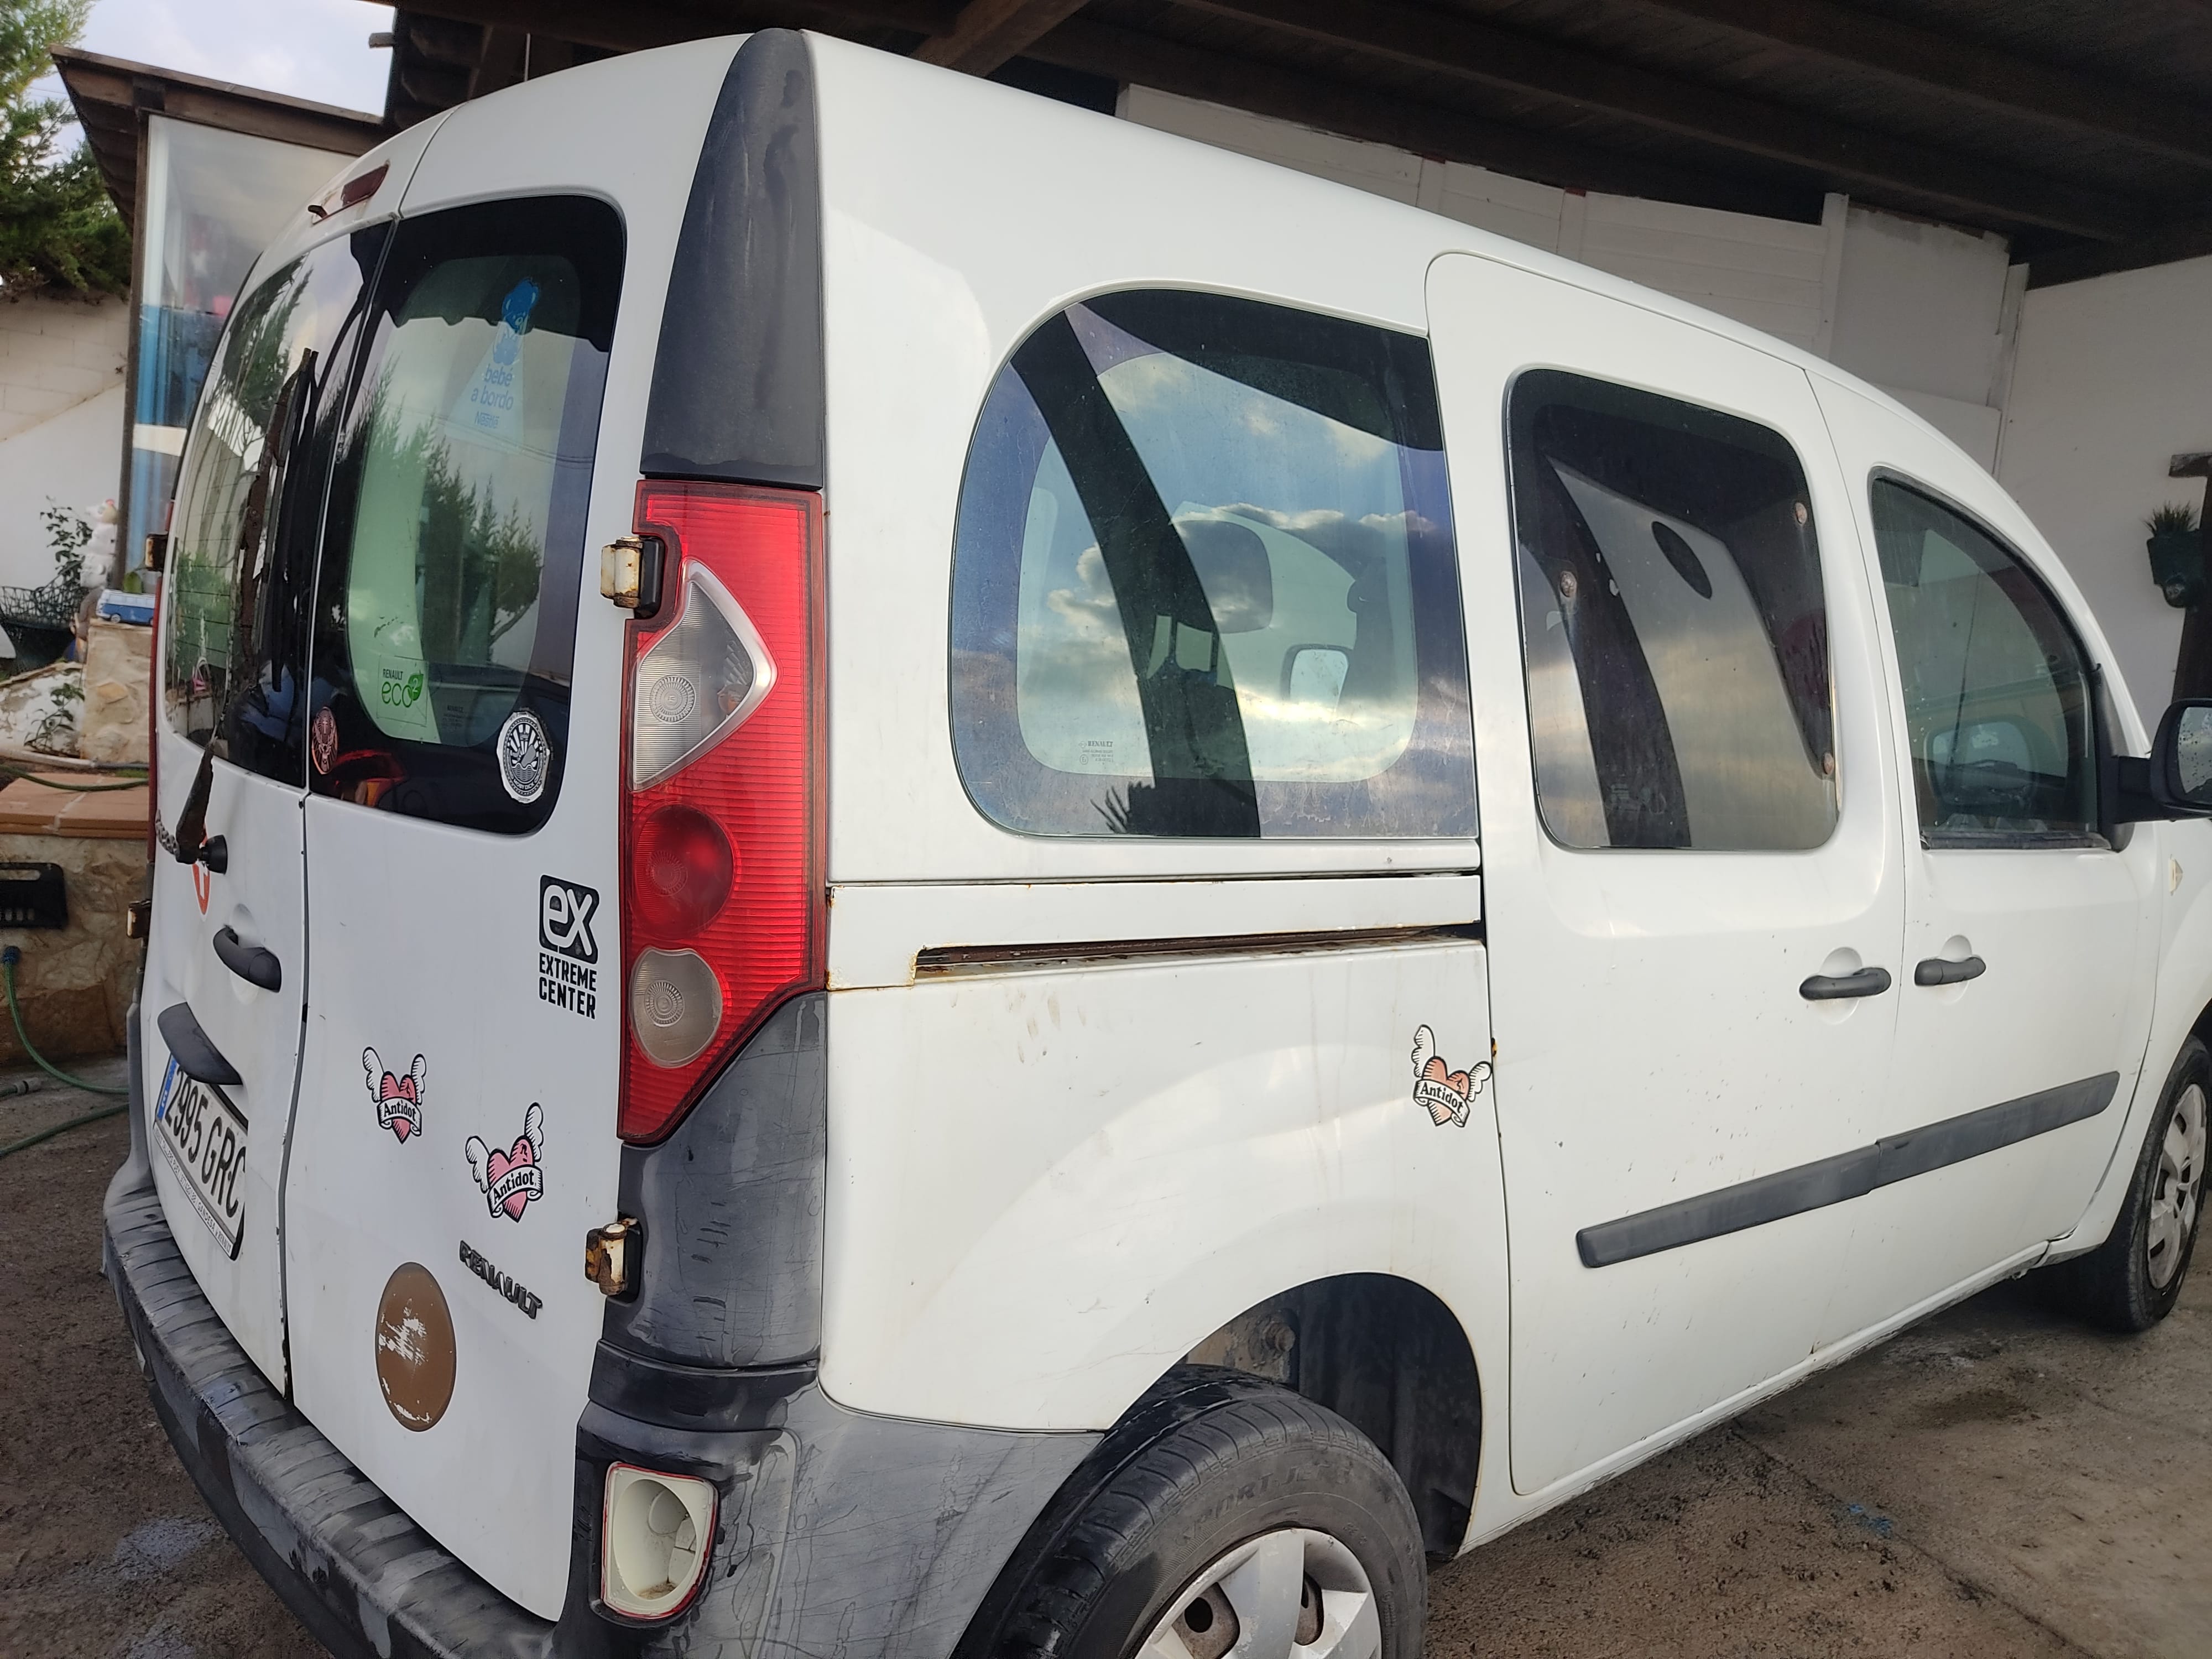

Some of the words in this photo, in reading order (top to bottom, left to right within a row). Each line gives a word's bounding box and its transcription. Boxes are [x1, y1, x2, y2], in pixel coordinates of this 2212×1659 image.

[484, 363, 514, 387] bebé
[471, 387, 479, 402] a
[480, 385, 514, 410] bordo
[382, 668, 404, 681] RENAULT
[539, 952, 597, 992] EXTREME
[539, 976, 596, 1020] CENTER
[383, 1100, 417, 1119] Antidot
[1419, 1082, 1464, 1114] Antidot
[201, 1116, 247, 1218] GRC
[492, 1170, 535, 1204] Antidot
[459, 1240, 543, 1320] RENAULT
